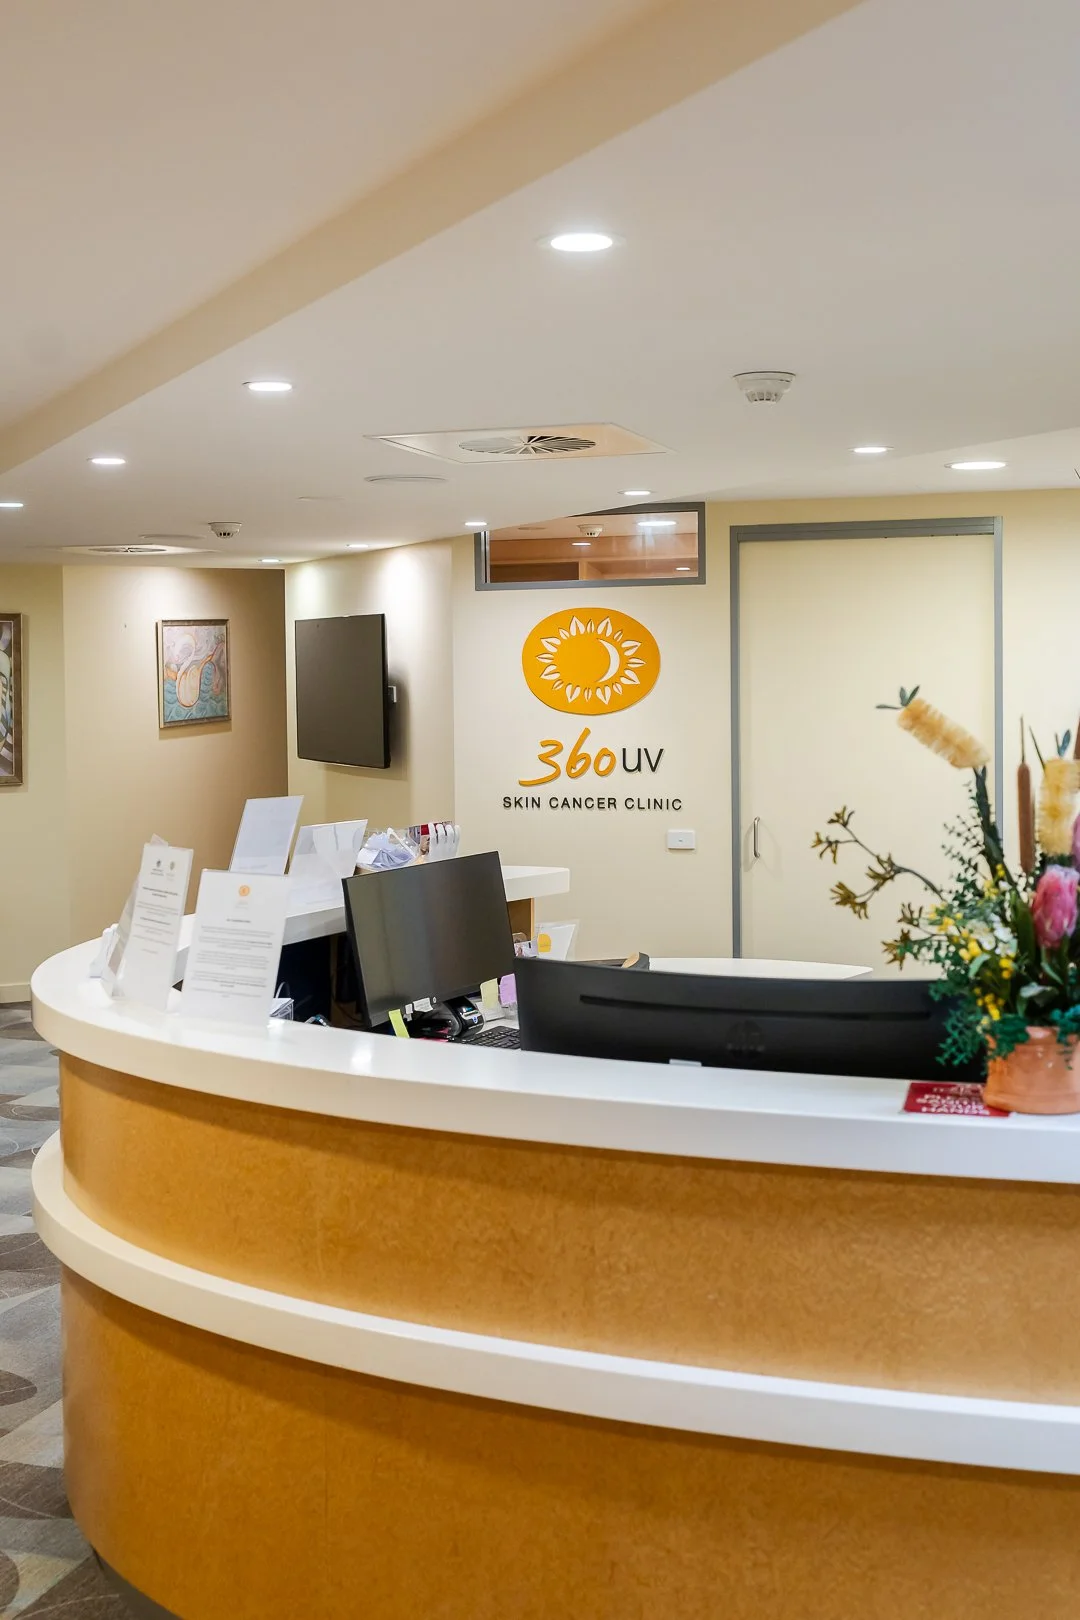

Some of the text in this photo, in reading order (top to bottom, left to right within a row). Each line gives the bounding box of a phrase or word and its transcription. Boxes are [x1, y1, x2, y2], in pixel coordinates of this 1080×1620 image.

[502, 796, 682, 811] SKIN CANCER CLINIC
